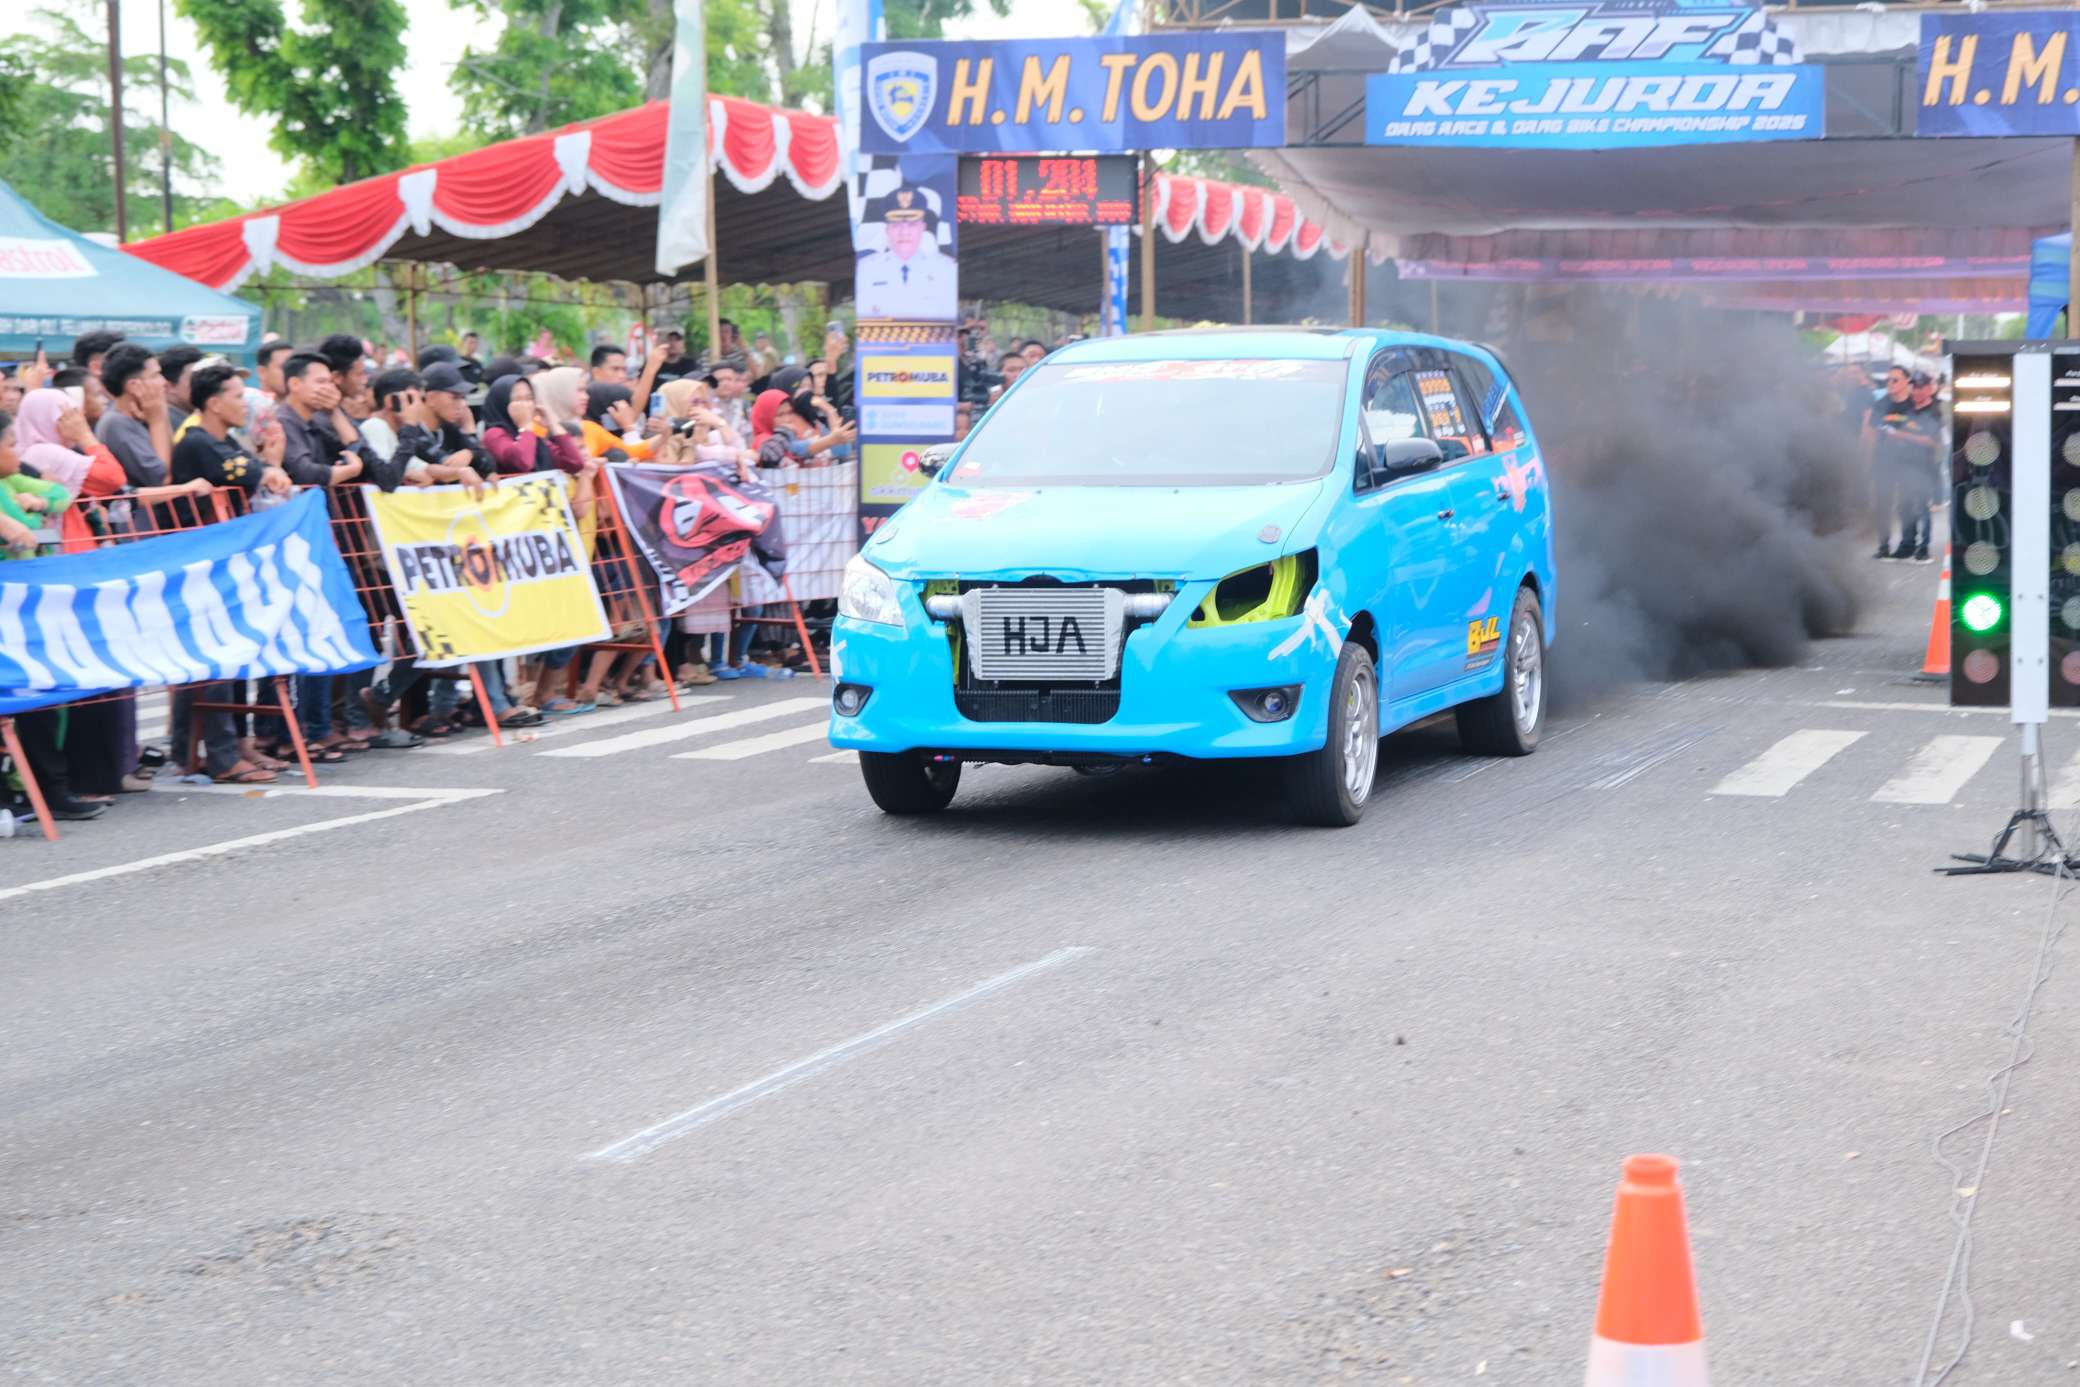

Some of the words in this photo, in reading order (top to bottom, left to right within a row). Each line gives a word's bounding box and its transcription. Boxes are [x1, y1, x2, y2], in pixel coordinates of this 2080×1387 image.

[1101, 49, 1268, 123] TOHA
[1402, 73, 1798, 117] KEJURDA
[867, 371, 949, 383] PETROMUBA
[396, 528, 579, 592] PETROMUBA
[1003, 616, 1087, 655] HJA
